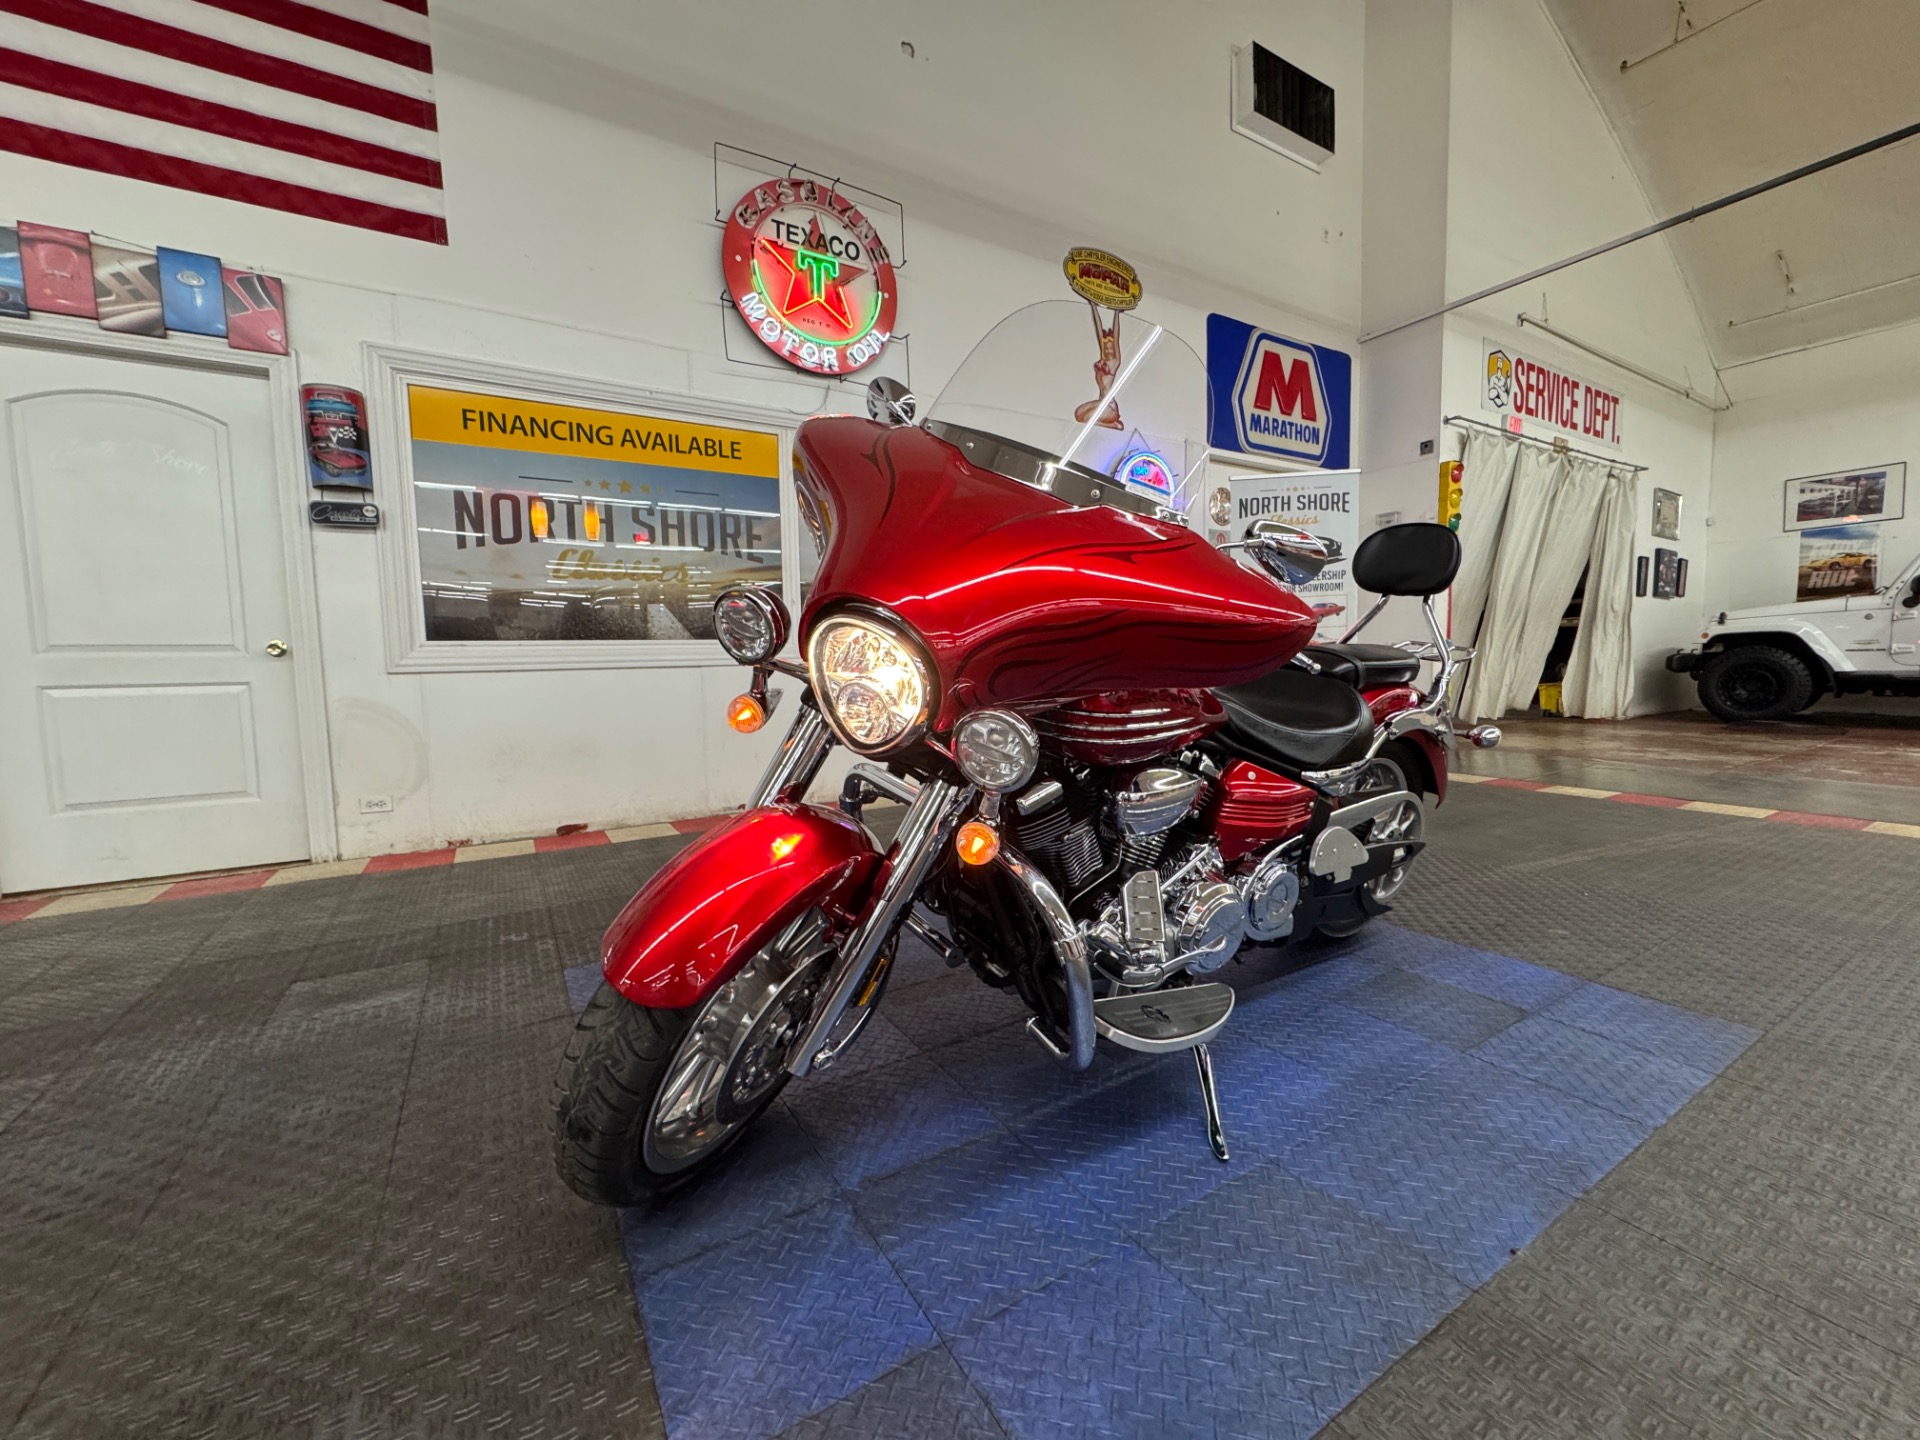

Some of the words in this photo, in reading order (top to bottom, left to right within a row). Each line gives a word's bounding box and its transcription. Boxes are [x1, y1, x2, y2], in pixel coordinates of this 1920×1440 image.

[771, 219, 860, 261] TEXACO
[797, 248, 838, 301] T
[1079, 263, 1130, 295] MOPAR
[741, 291, 839, 371] MOTOR
[847, 330, 890, 367] OIL
[802, 317, 815, 325] REG
[1253, 349, 1317, 422] M
[1513, 357, 1579, 432] SERVICE
[1583, 385, 1620, 445] DEPT.
[461, 408, 614, 447] FINANCING
[620, 429, 742, 461] AVAILABLE
[1250, 413, 1320, 445] MARATHON
[1239, 495, 1291, 519] NORTH
[1297, 492, 1350, 513] SHORE
[1270, 514, 1319, 526] Classics
[453, 489, 615, 551] NORTH
[631, 506, 764, 564] SHORE
[551, 547, 694, 584] Classics
[1298, 582, 1344, 593] SHOWROOM!
